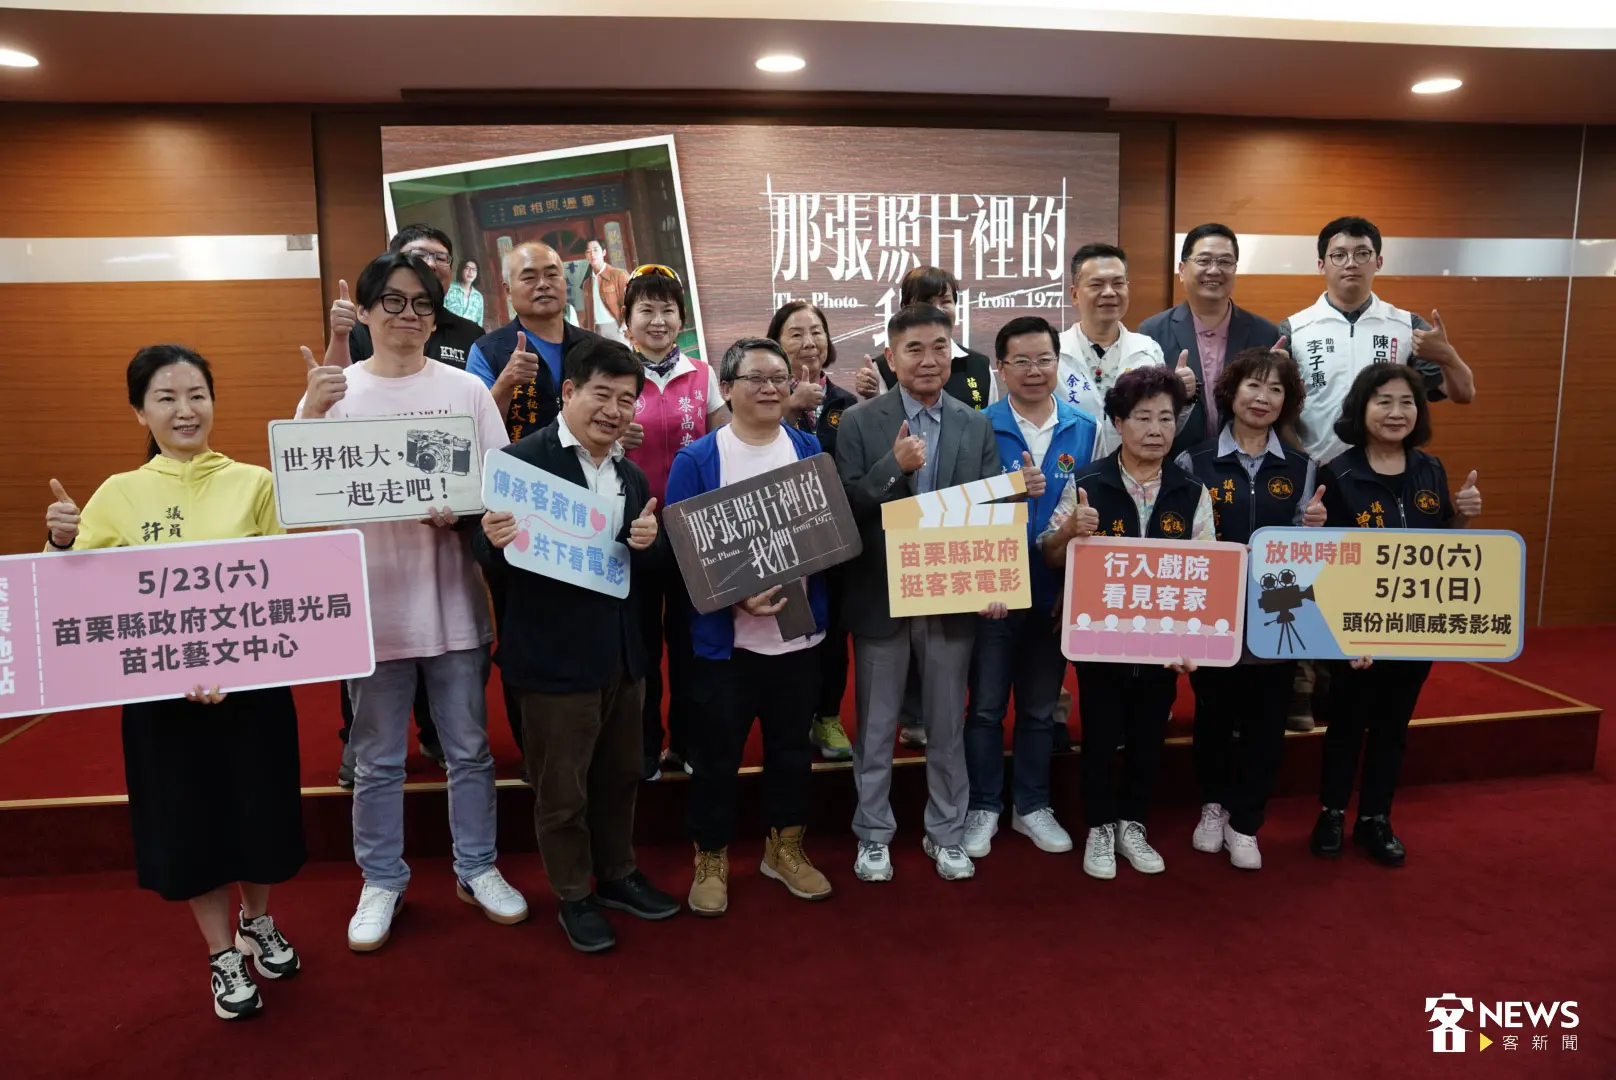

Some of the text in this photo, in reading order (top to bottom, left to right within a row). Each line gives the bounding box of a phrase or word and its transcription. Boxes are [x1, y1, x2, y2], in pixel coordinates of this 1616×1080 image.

[772, 193, 1065, 282] 那張照片裡的
[774, 292, 858, 309] Th Photo
[978, 292, 1063, 308] from 1977
[440, 346, 464, 360] KMT
[493, 468, 588, 528] 傳承客家情
[1223, 479, 1236, 504] 議員
[165, 505, 184, 538] 議員
[687, 471, 828, 553] 那張照片裡的
[792, 512, 832, 534] from 1977
[141, 521, 164, 542] 許
[533, 532, 625, 586] 共下看電影
[701, 548, 741, 567] The Photo
[748, 527, 799, 579] 我們
[899, 538, 1019, 568] 苗栗縣政府
[1104, 552, 1210, 581] 行入戲院
[1265, 540, 1482, 571] 放映時間 5/30(六)
[138, 558, 270, 598] 5/23(六)
[900, 568, 1022, 598] 挺客家電影
[1375, 576, 1481, 604] 5/31(日)
[1102, 583, 1207, 612] 看見客家
[52, 593, 352, 646] 苗栗縣政府文化觀光局
[1342, 612, 1512, 635] 頭份尚順威秀影城
[120, 633, 299, 676] 苗北藝文中心
